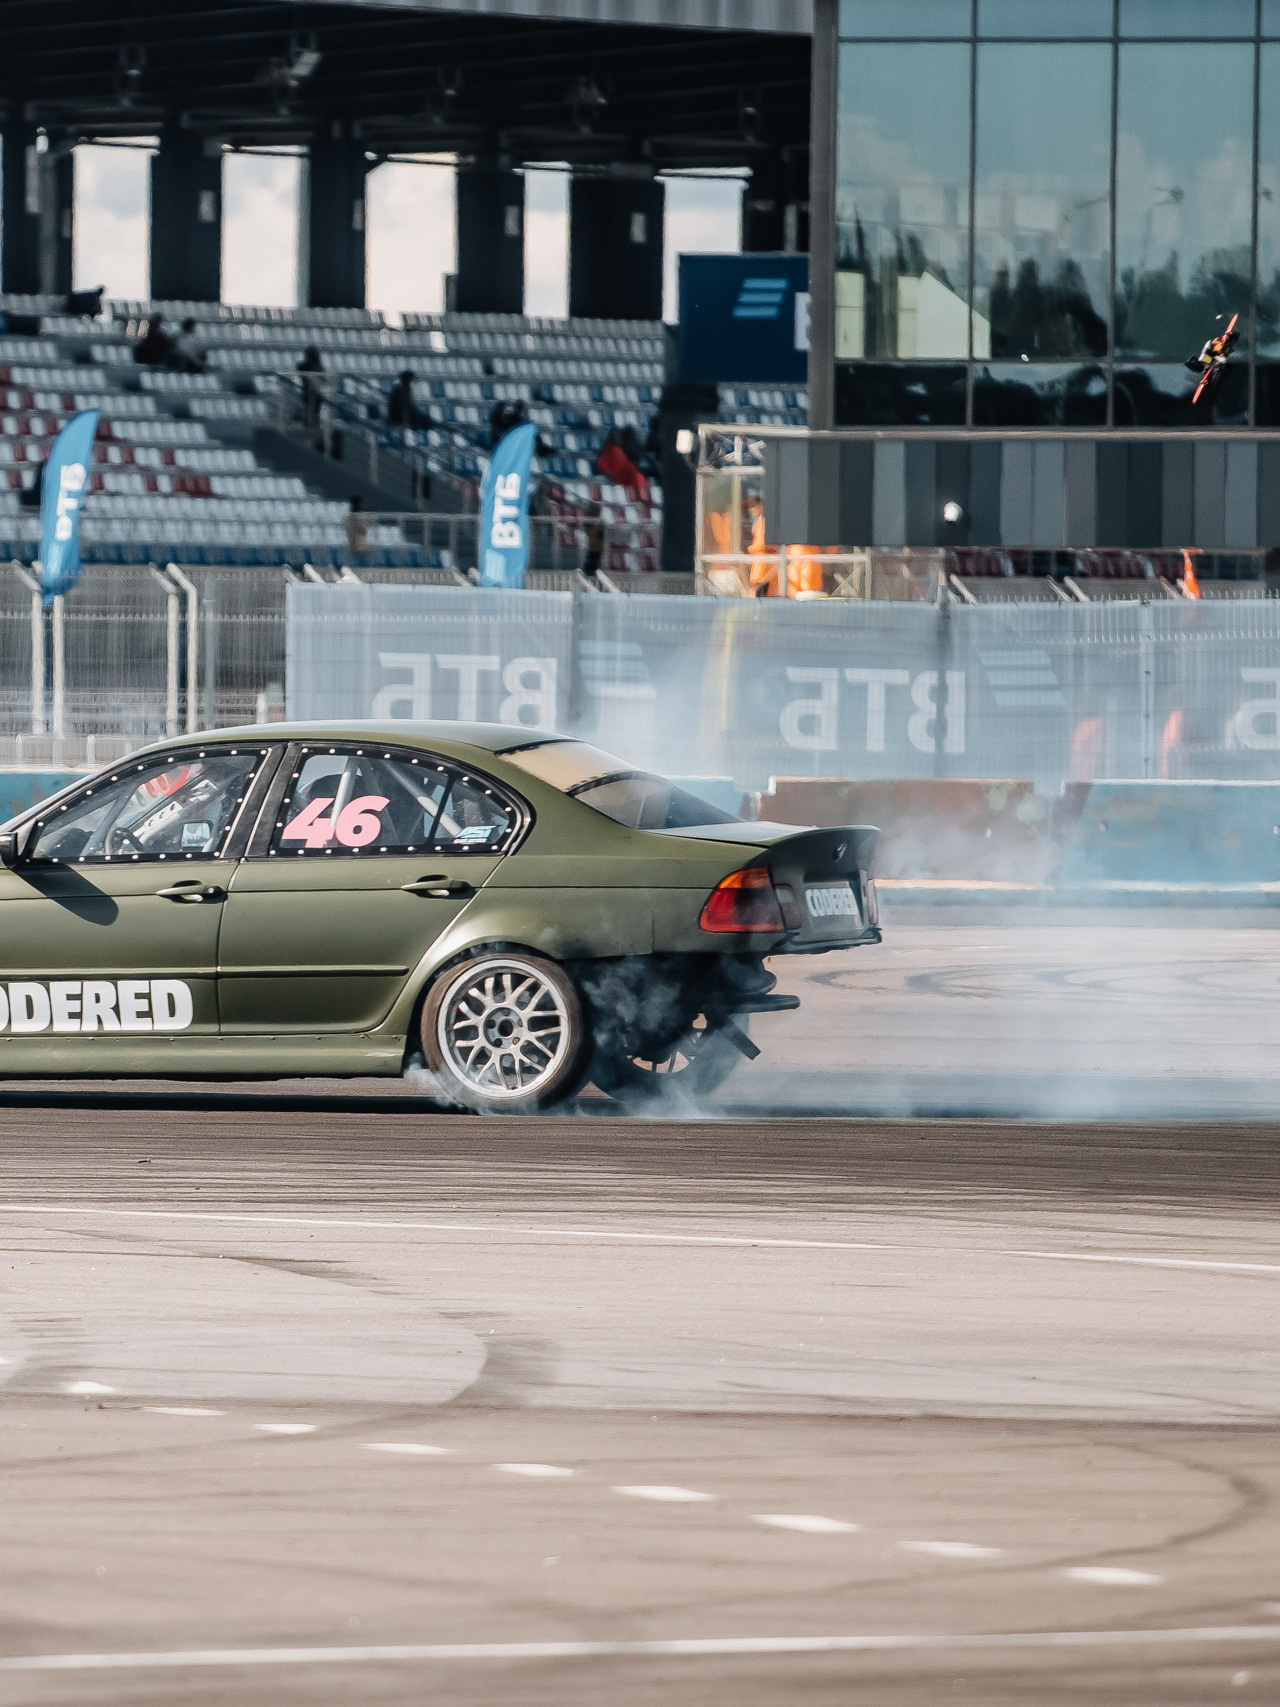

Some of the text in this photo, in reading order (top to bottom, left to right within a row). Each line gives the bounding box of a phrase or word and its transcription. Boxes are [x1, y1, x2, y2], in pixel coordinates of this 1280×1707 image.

[55, 463, 86, 541] ВТБ
[491, 473, 522, 548] ВТБ
[282, 795, 390, 848] 46
